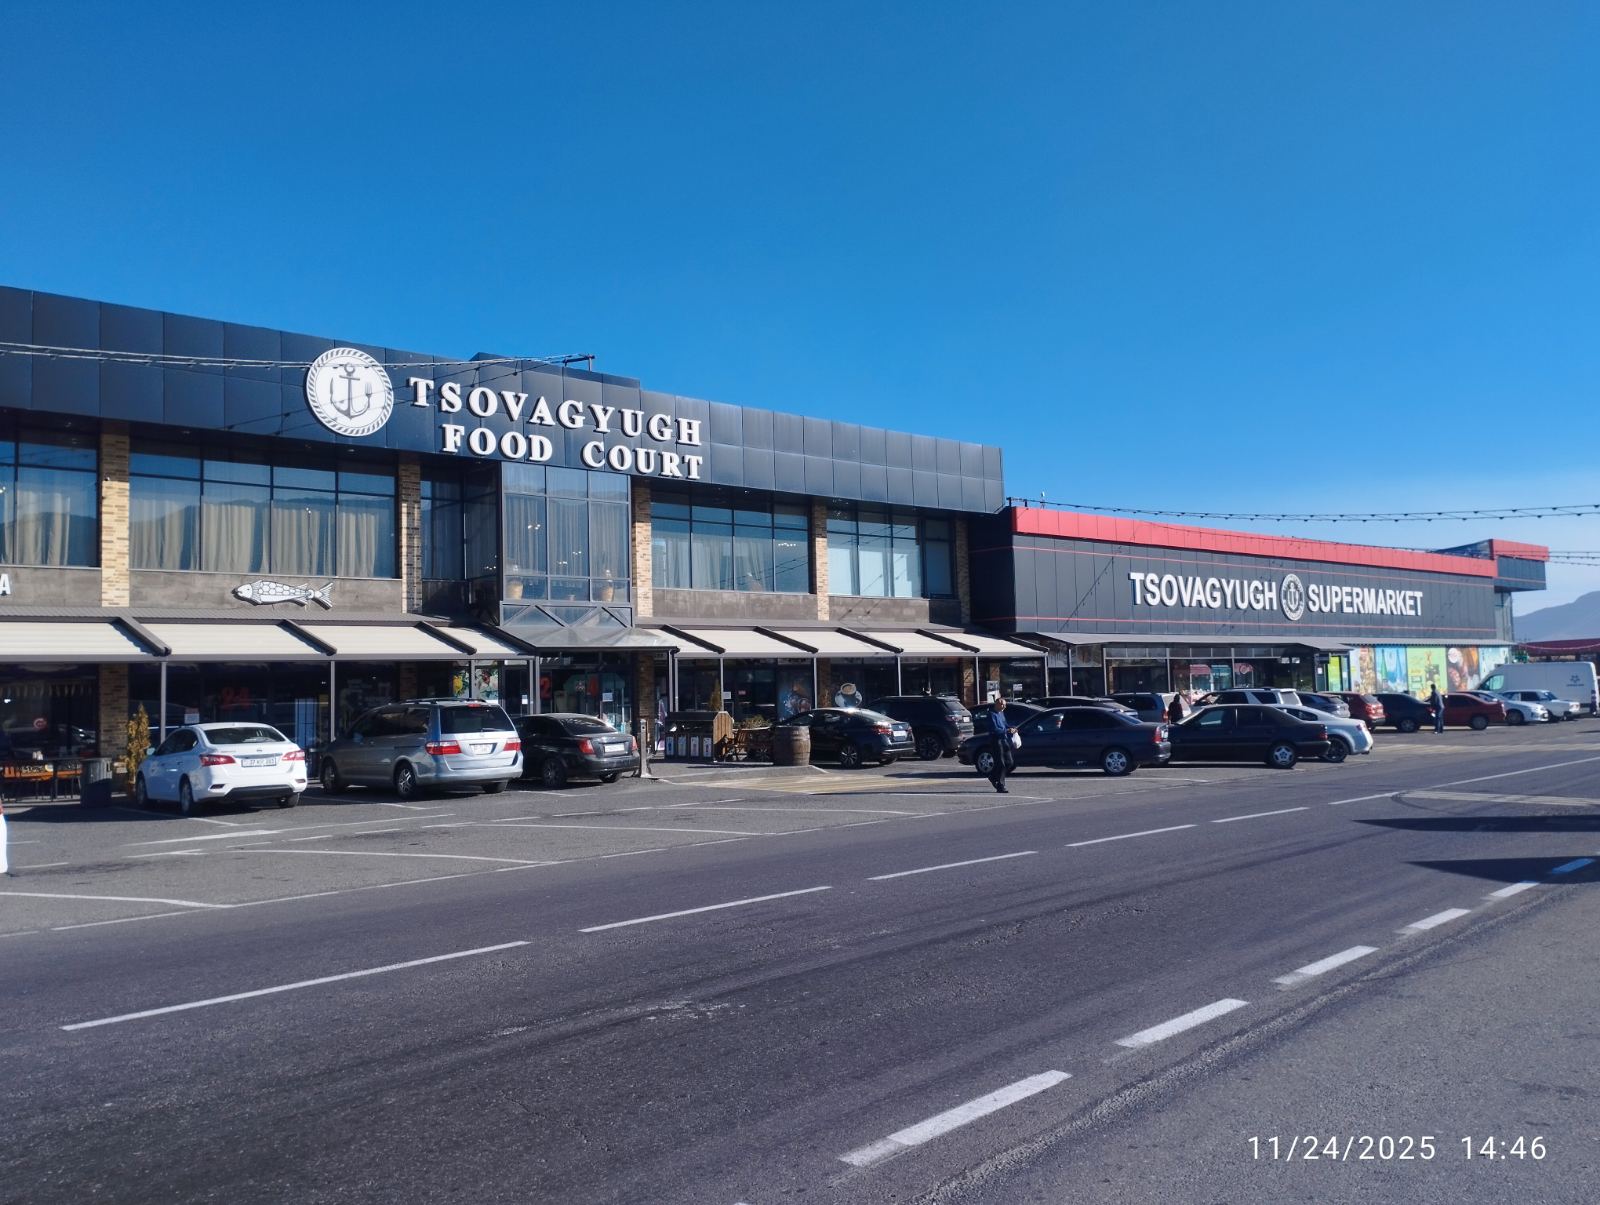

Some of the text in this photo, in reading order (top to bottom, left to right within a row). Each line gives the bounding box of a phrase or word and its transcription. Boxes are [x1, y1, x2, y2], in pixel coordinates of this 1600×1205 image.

[409, 376, 703, 446] TSOVAGYUGH
[442, 423, 703, 480] FOOD COURT
[1128, 572, 1424, 616] TSOVAGYUGH SUPERMARKET
